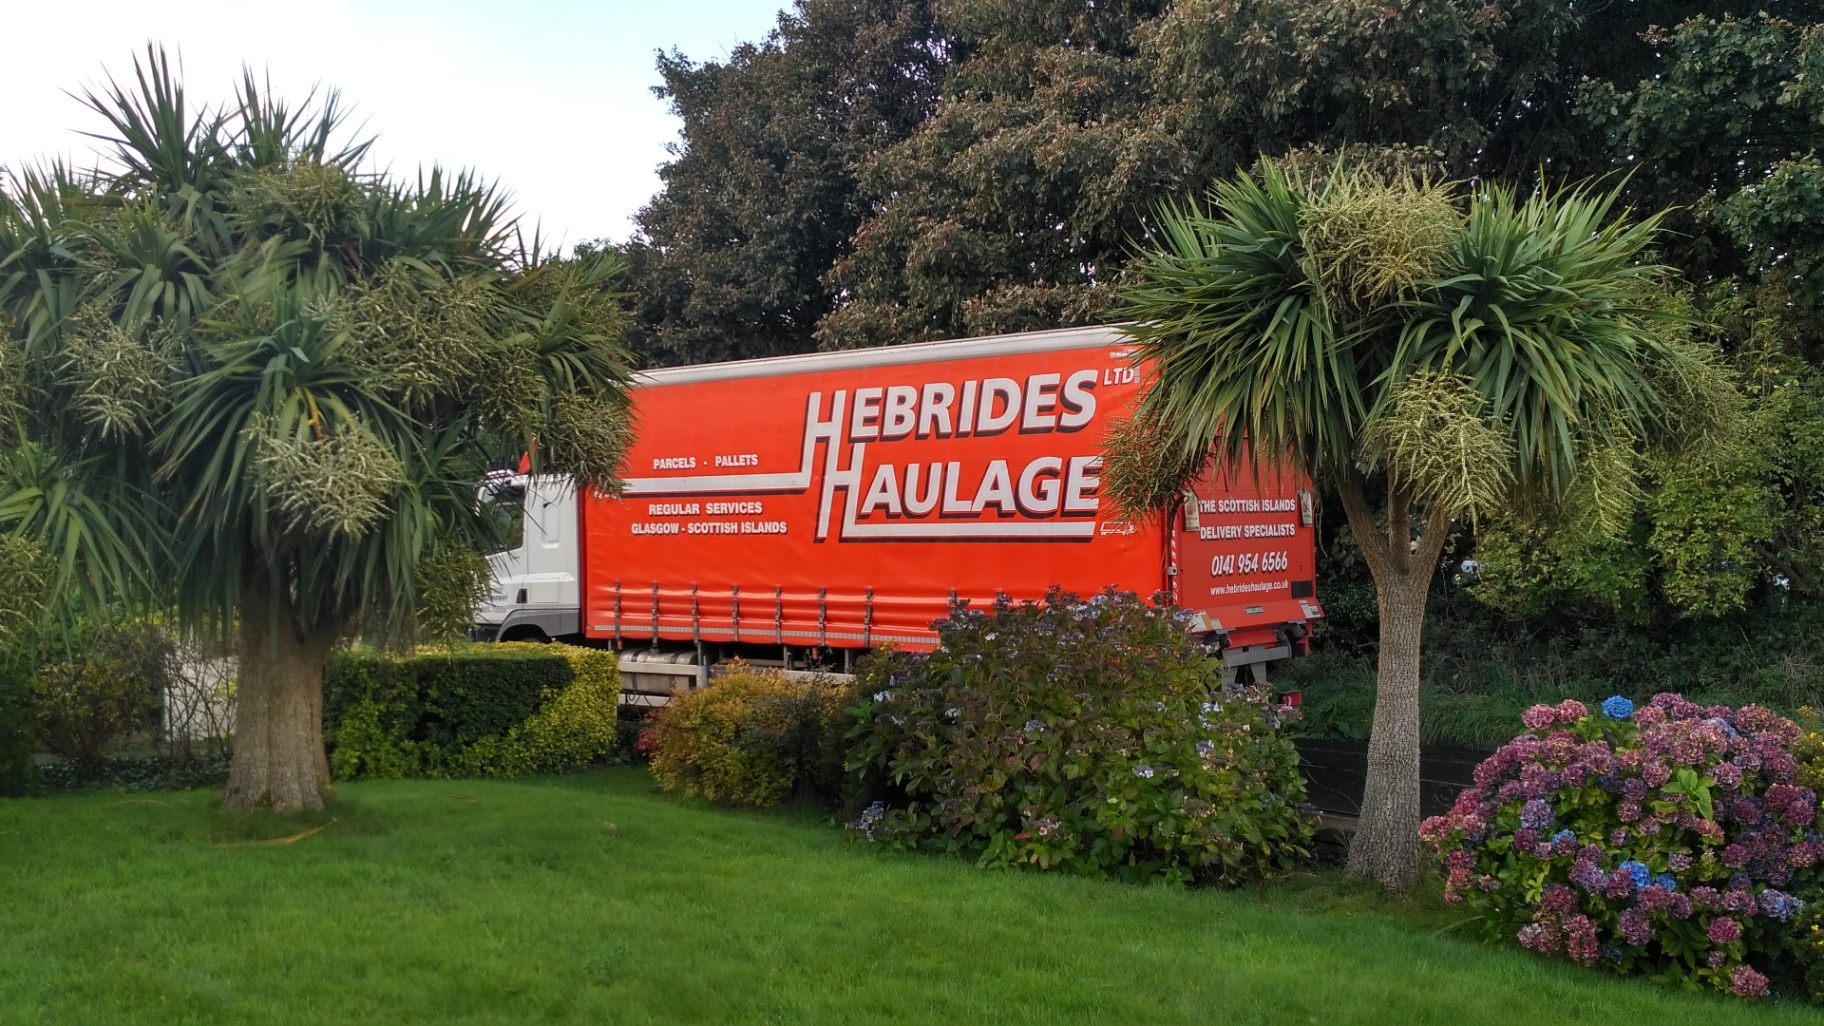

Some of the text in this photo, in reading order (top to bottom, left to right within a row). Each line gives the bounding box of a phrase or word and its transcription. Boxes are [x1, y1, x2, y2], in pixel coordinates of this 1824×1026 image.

[801, 368, 1134, 475] HEBRIDES LTD
[653, 454, 758, 470] PARCELS PALLETS
[815, 443, 1102, 539] HAULAGE
[649, 502, 763, 515] REGULAR SERVICES
[1199, 499, 1296, 513] THE SCOTTISH ISLANDS
[631, 521, 787, 534] GLASGOW SCOTTISH ISLANDS
[1200, 523, 1295, 540] DELIVERY SPECIALISTS
[1211, 550, 1288, 577] 0141 954 6566
[1210, 579, 1289, 596] www.hebrideshaulage.co.uk
